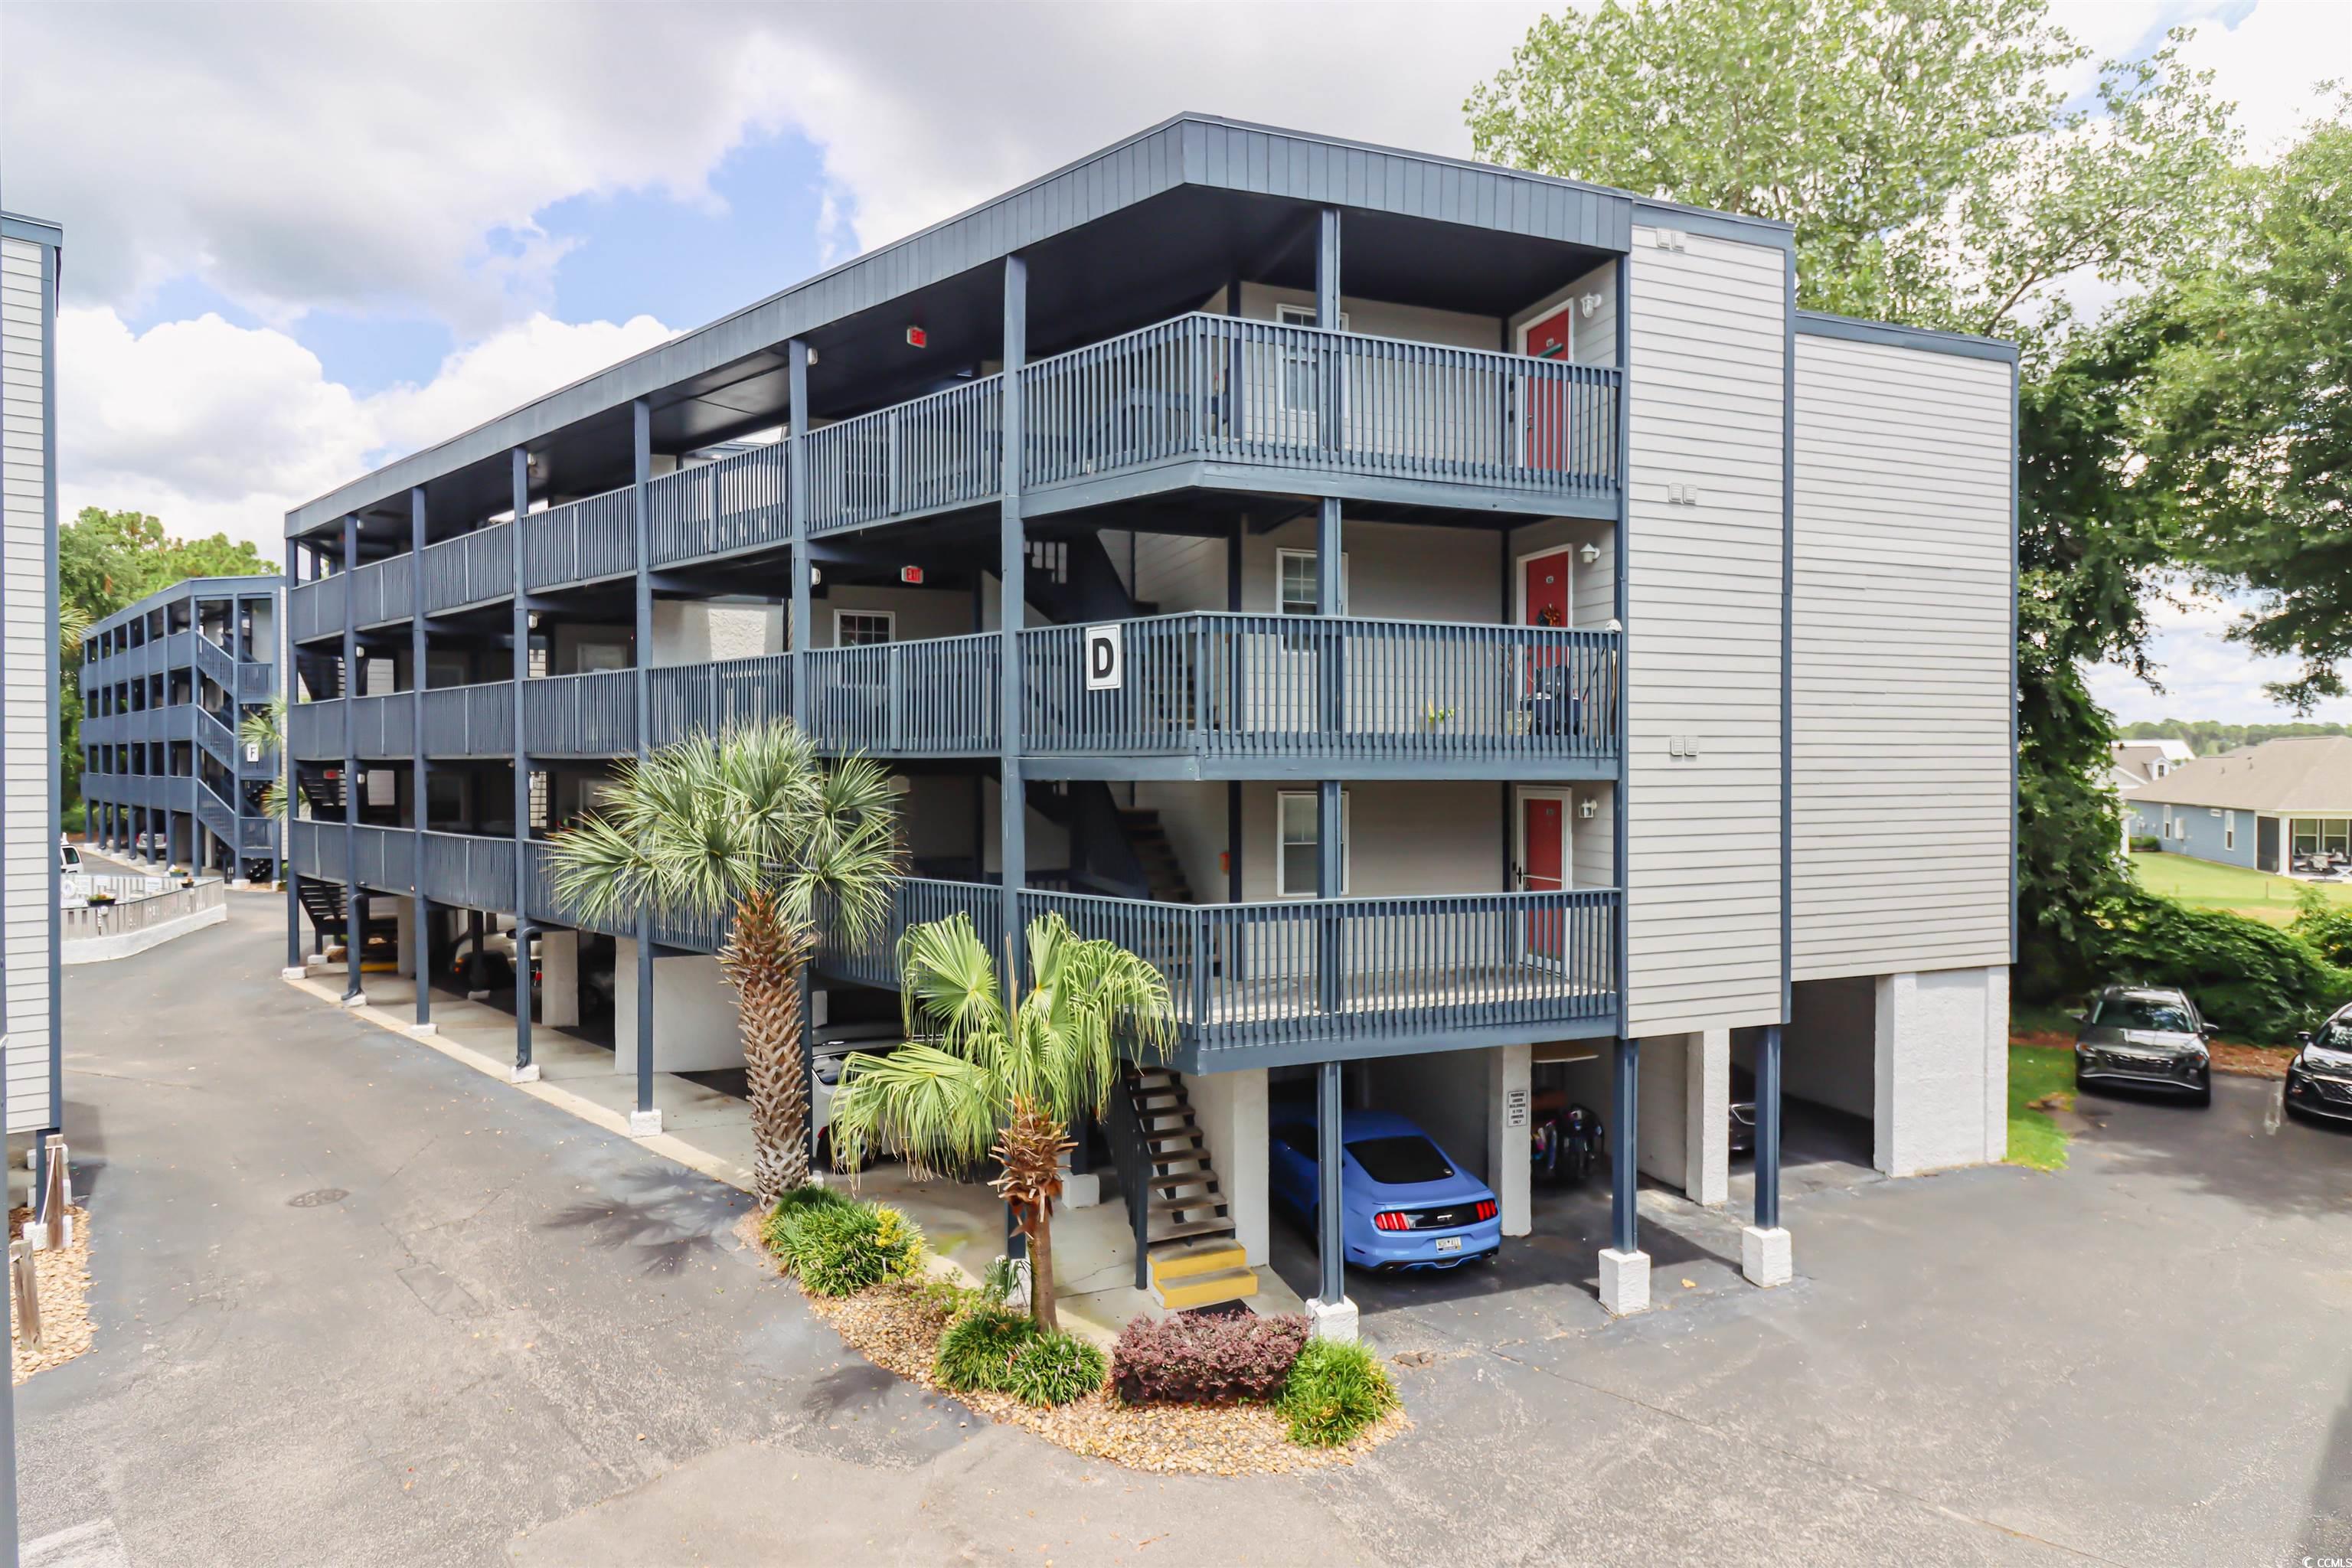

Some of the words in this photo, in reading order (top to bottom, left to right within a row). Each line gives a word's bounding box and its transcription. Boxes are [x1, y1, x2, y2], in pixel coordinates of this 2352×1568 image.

[906, 567, 922, 581] EXIT
[1093, 638, 1114, 679] D
[250, 746, 257, 758] F
